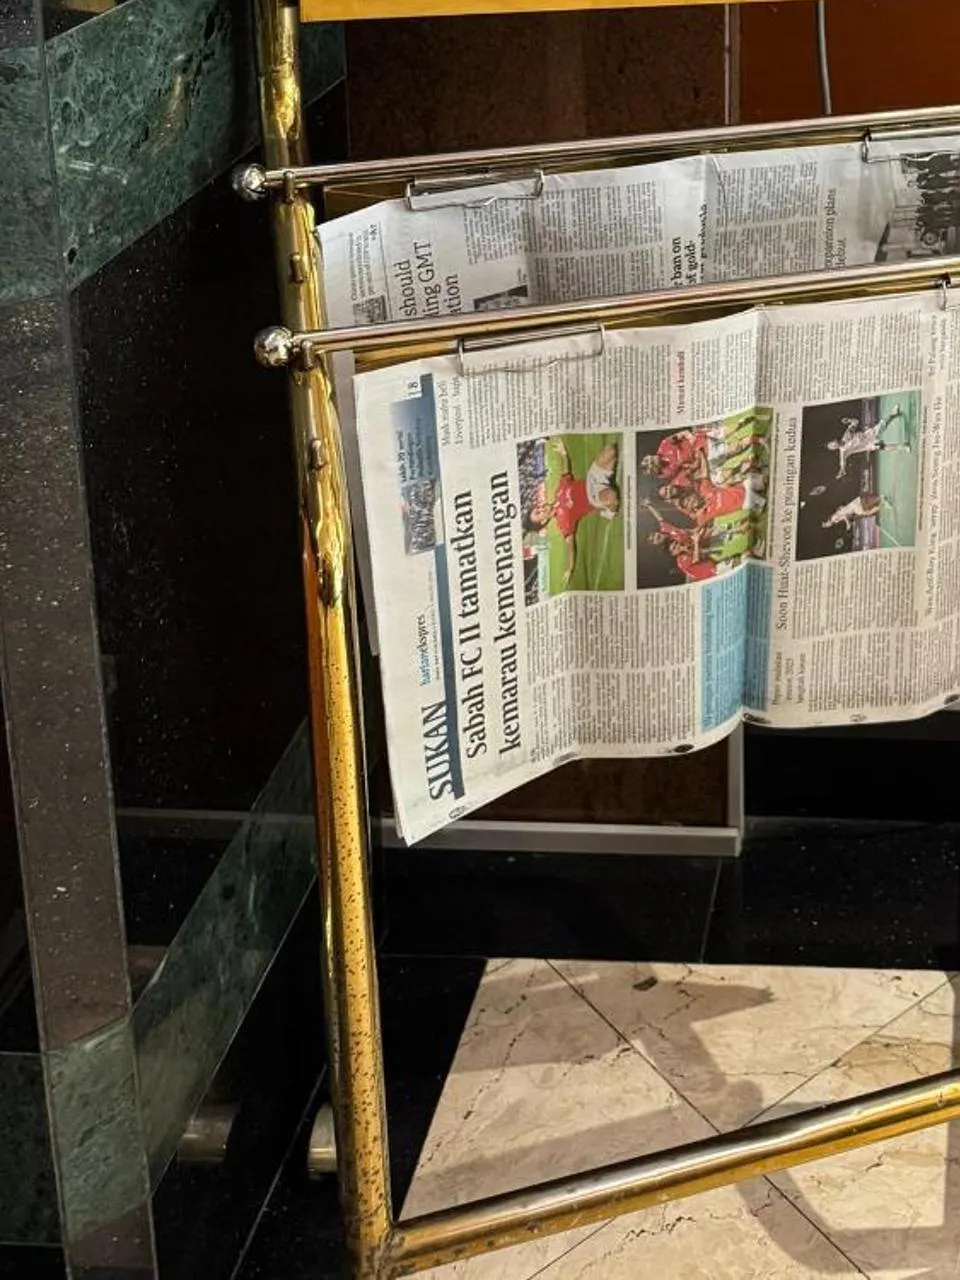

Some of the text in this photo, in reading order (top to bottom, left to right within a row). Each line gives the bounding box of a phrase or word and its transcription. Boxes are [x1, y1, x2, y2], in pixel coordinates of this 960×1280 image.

[413, 241, 435, 282] GMT
[670, 236, 682, 281] ban on
[684, 240, 698, 271] gold-
[394, 259, 417, 316] should
[784, 417, 798, 452] kedua
[781, 455, 798, 507] pusingan
[780, 509, 793, 524] ke
[450, 490, 480, 620] tamatkan
[489, 470, 522, 756] kemarau kemenangan
[775, 601, 789, 631] Soon
[460, 646, 483, 681] FC
[462, 683, 487, 760] Sabah
[421, 704, 454, 801] SUKAN
